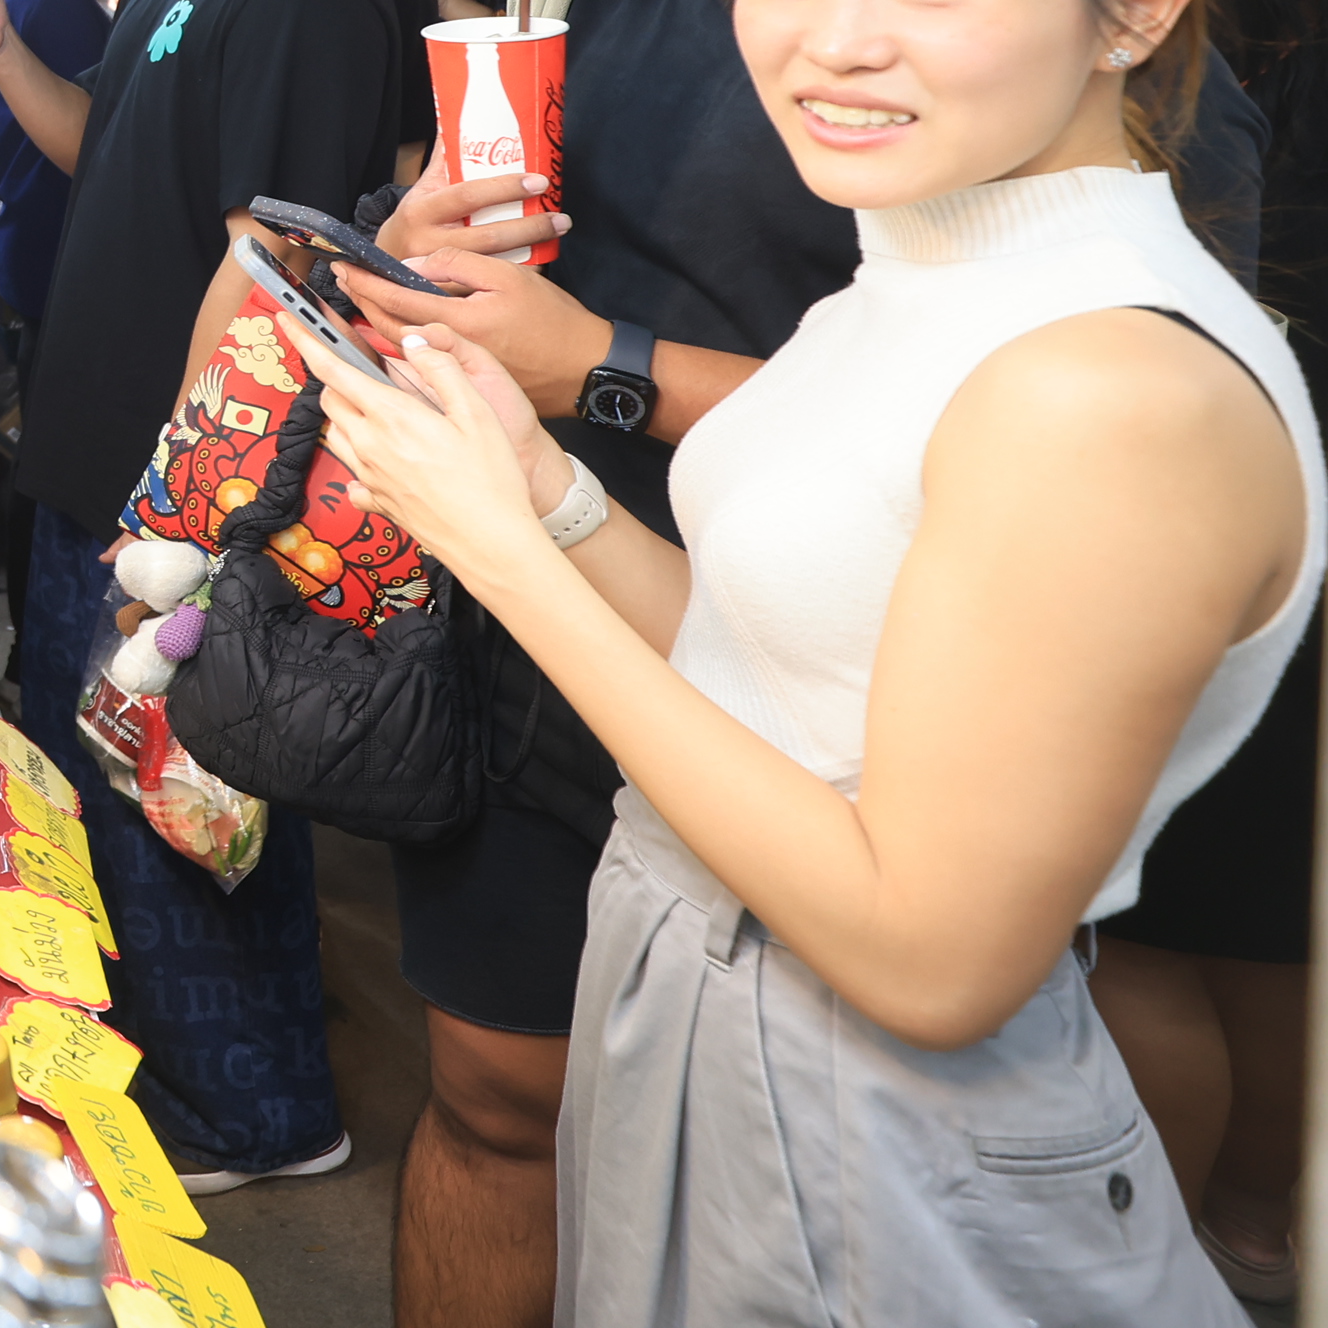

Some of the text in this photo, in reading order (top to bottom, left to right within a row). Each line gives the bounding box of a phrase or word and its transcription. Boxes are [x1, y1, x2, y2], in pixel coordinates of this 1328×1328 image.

[12, 909, 70, 984] มันม่วง
[12, 1024, 41, 1050] Taro
